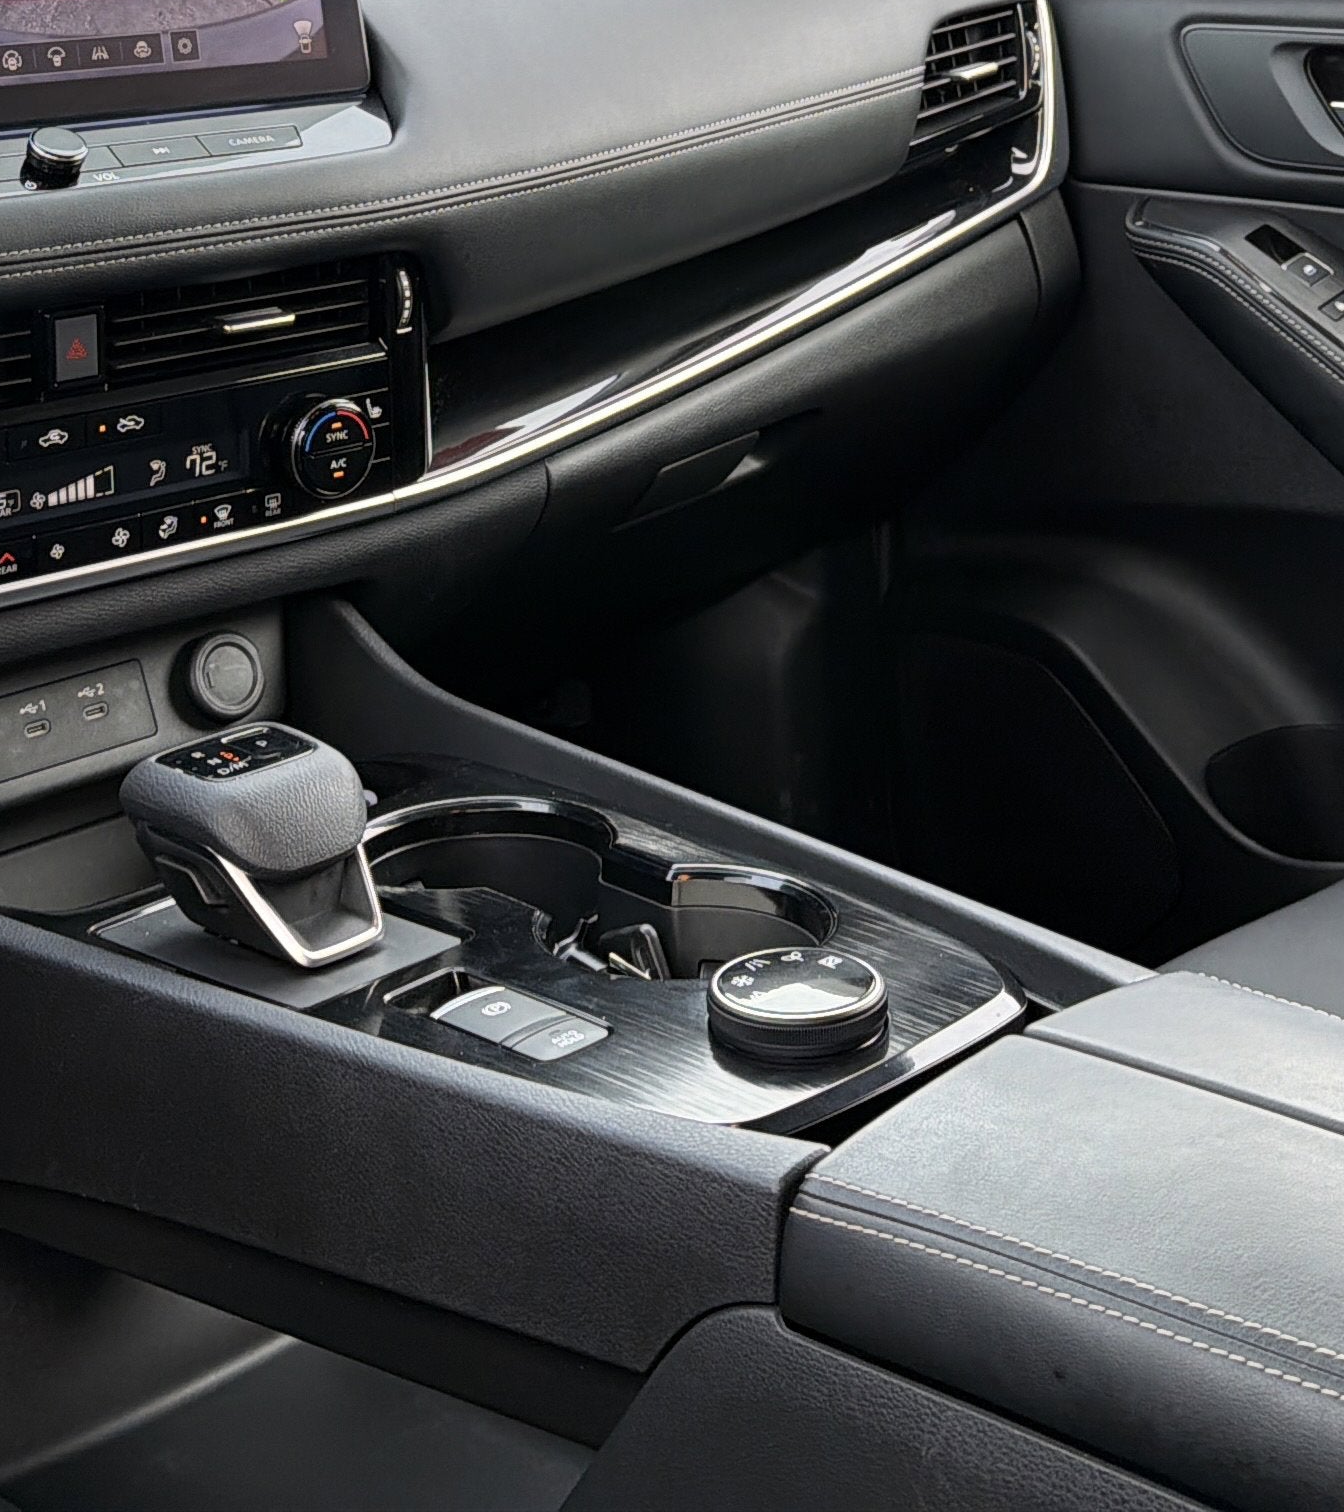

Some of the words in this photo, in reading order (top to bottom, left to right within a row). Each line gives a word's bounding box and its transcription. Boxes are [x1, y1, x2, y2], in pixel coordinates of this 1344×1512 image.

[228, 134, 275, 147] CAMERA
[92, 170, 121, 182] VOL
[325, 430, 349, 444] SYNC
[191, 442, 213, 455] SYNC
[330, 457, 348, 469] A/C
[213, 517, 235, 529] FRONT
